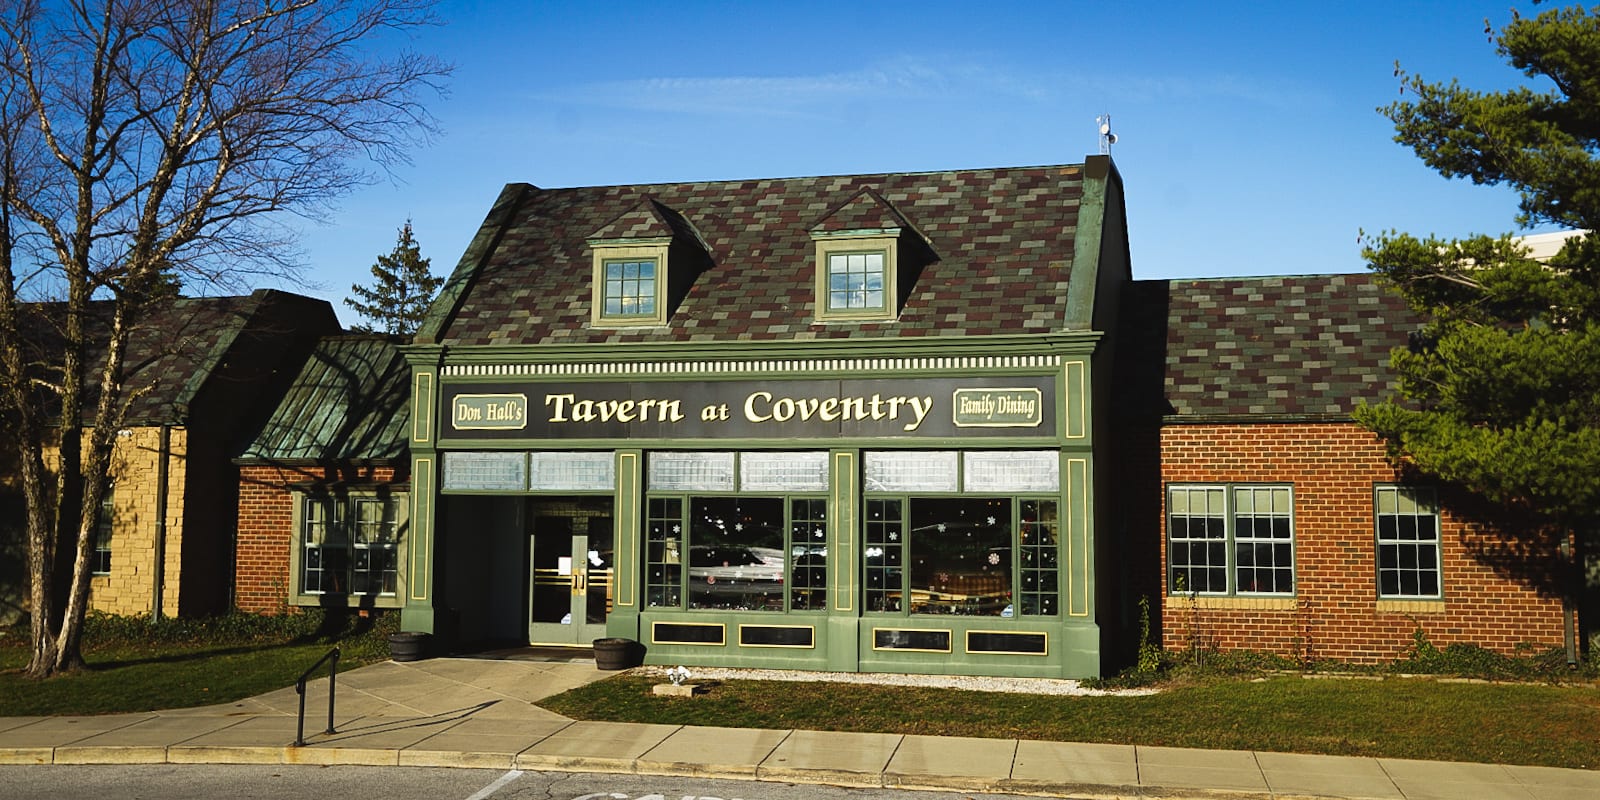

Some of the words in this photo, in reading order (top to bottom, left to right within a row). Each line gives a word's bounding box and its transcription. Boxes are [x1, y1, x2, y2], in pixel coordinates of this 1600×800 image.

[458, 404, 482, 421] Don
[487, 401, 523, 421] Hall's
[545, 394, 684, 423] Tavern
[701, 405, 731, 422] at
[744, 392, 932, 431] Coventry
[960, 394, 996, 420] Family
[997, 394, 1035, 418] Dining
